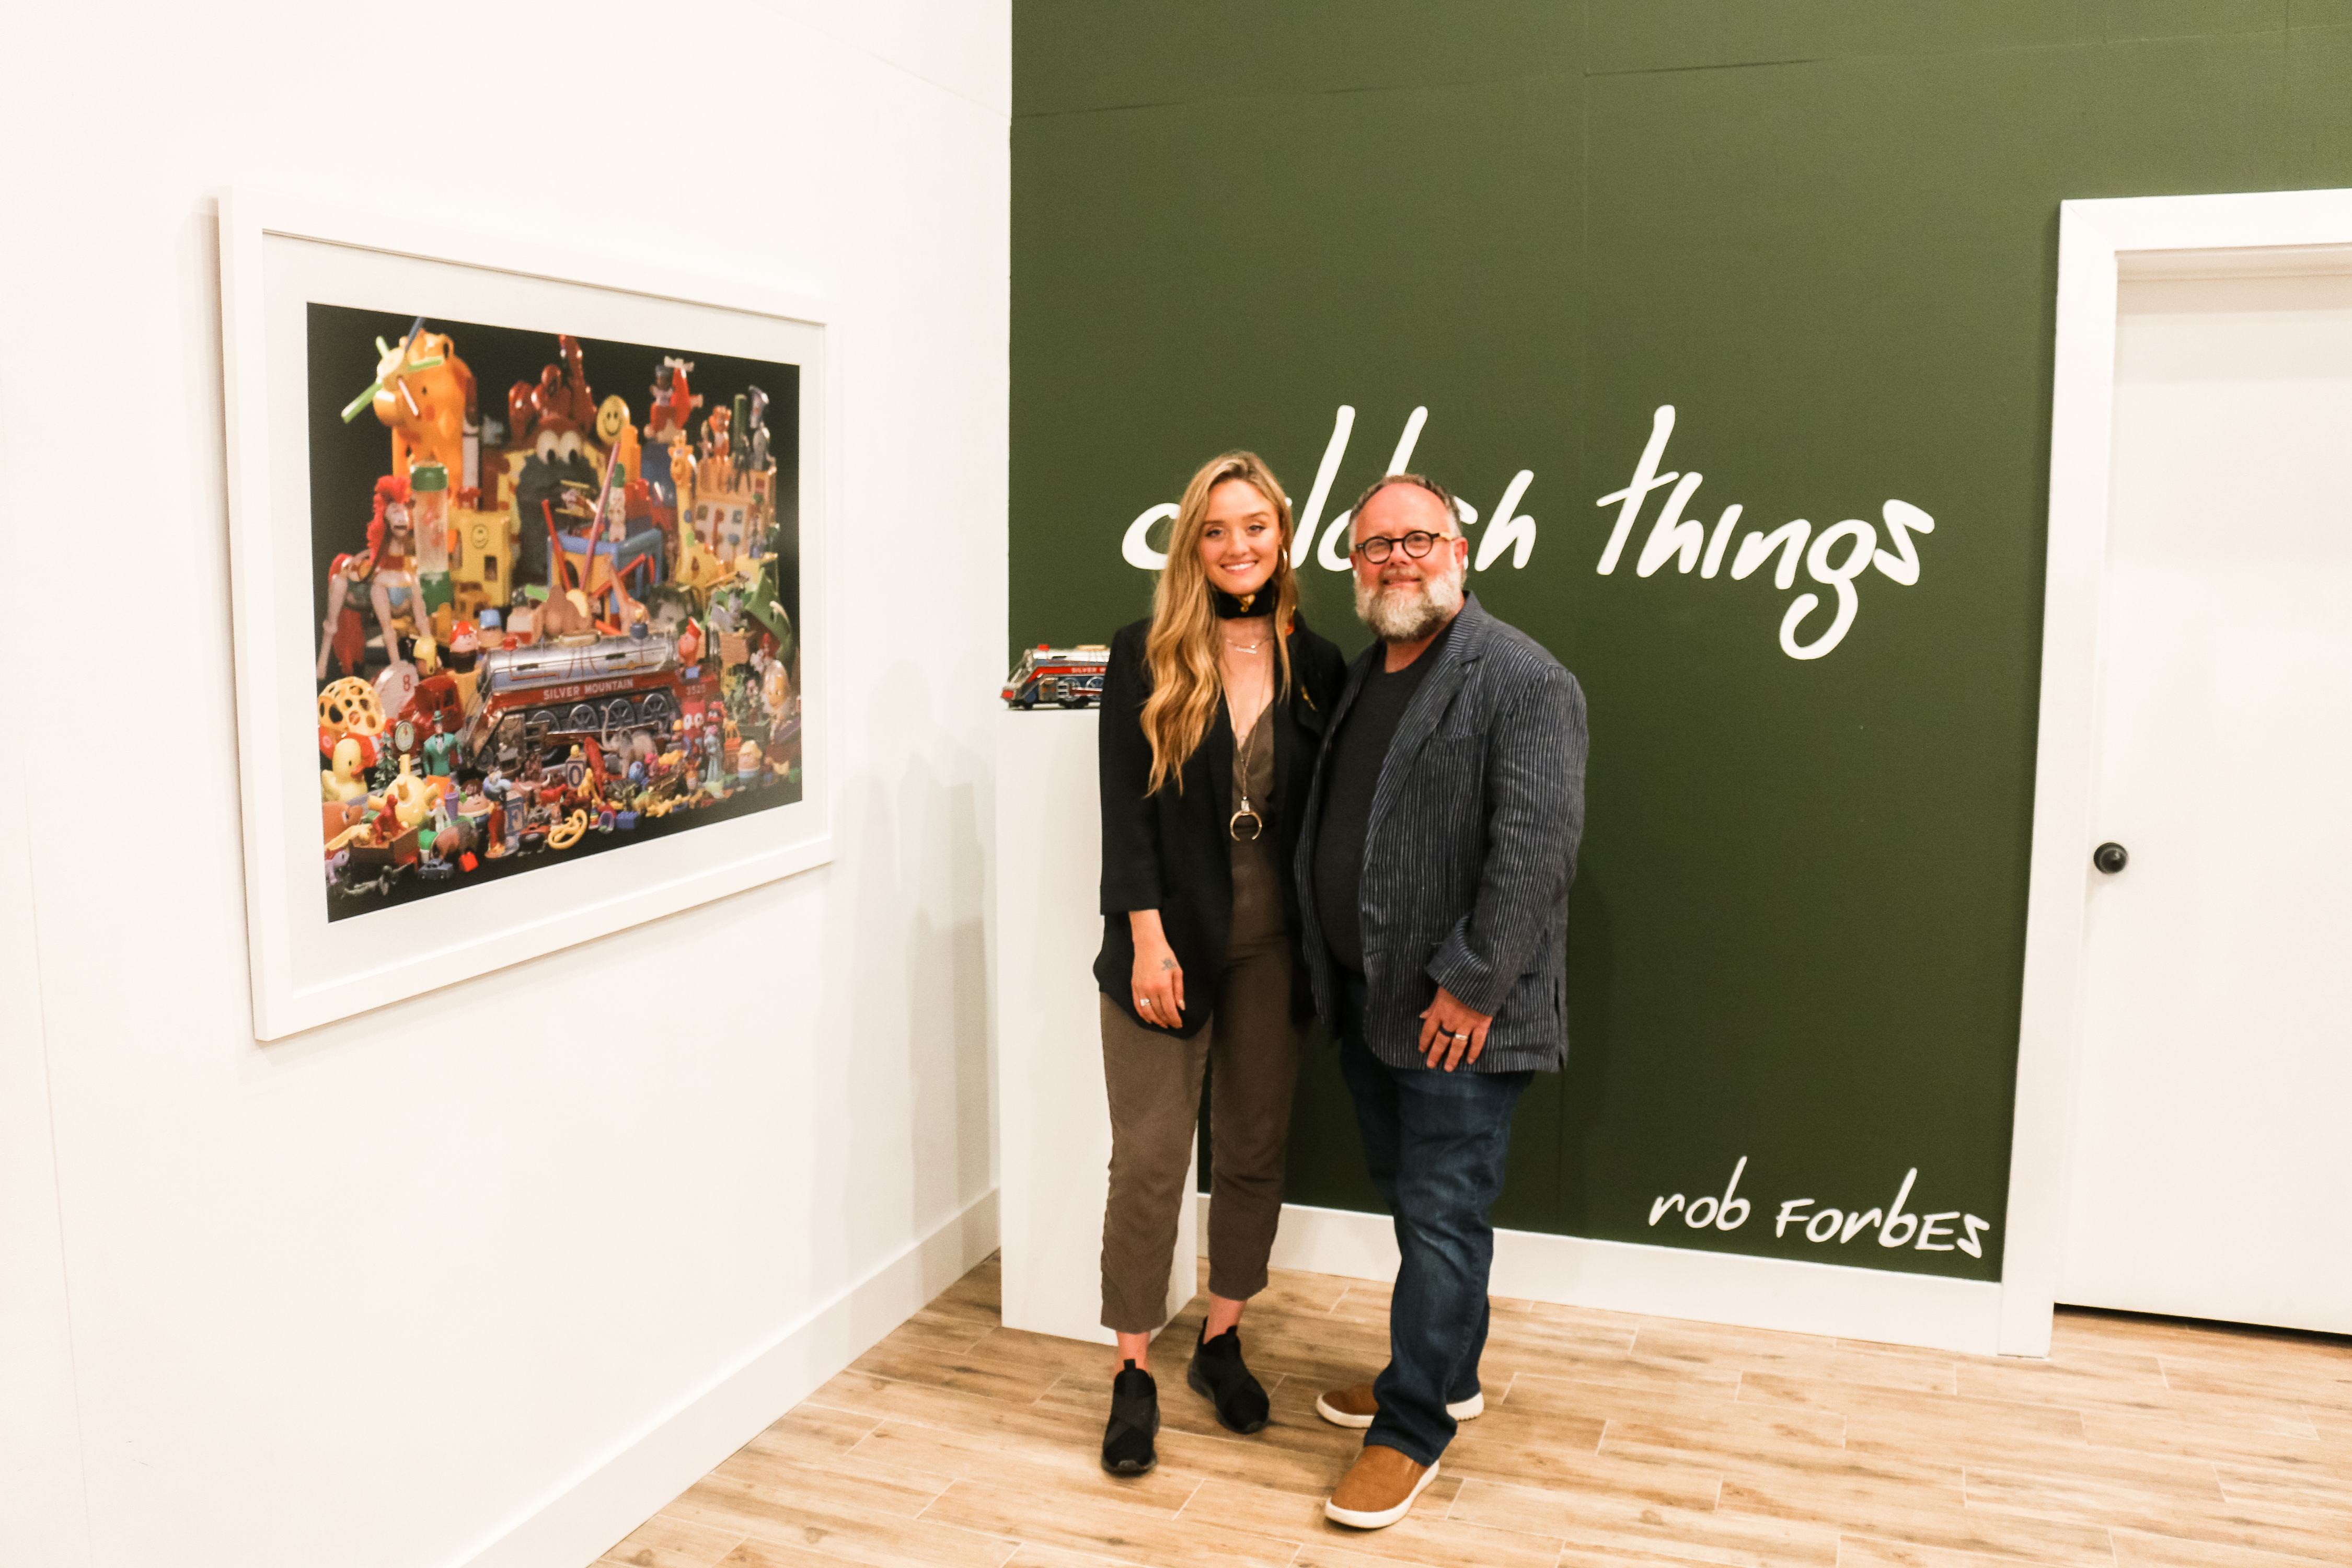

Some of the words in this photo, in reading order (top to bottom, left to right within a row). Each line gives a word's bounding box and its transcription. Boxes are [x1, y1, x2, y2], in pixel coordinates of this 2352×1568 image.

[1596, 404, 1935, 660] things
[403, 674, 411, 691] 8
[543, 685, 580, 700] SILVER
[584, 678, 633, 695] MOUNTAIN
[506, 804, 521, 831] F
[1648, 1156, 1750, 1231] rob
